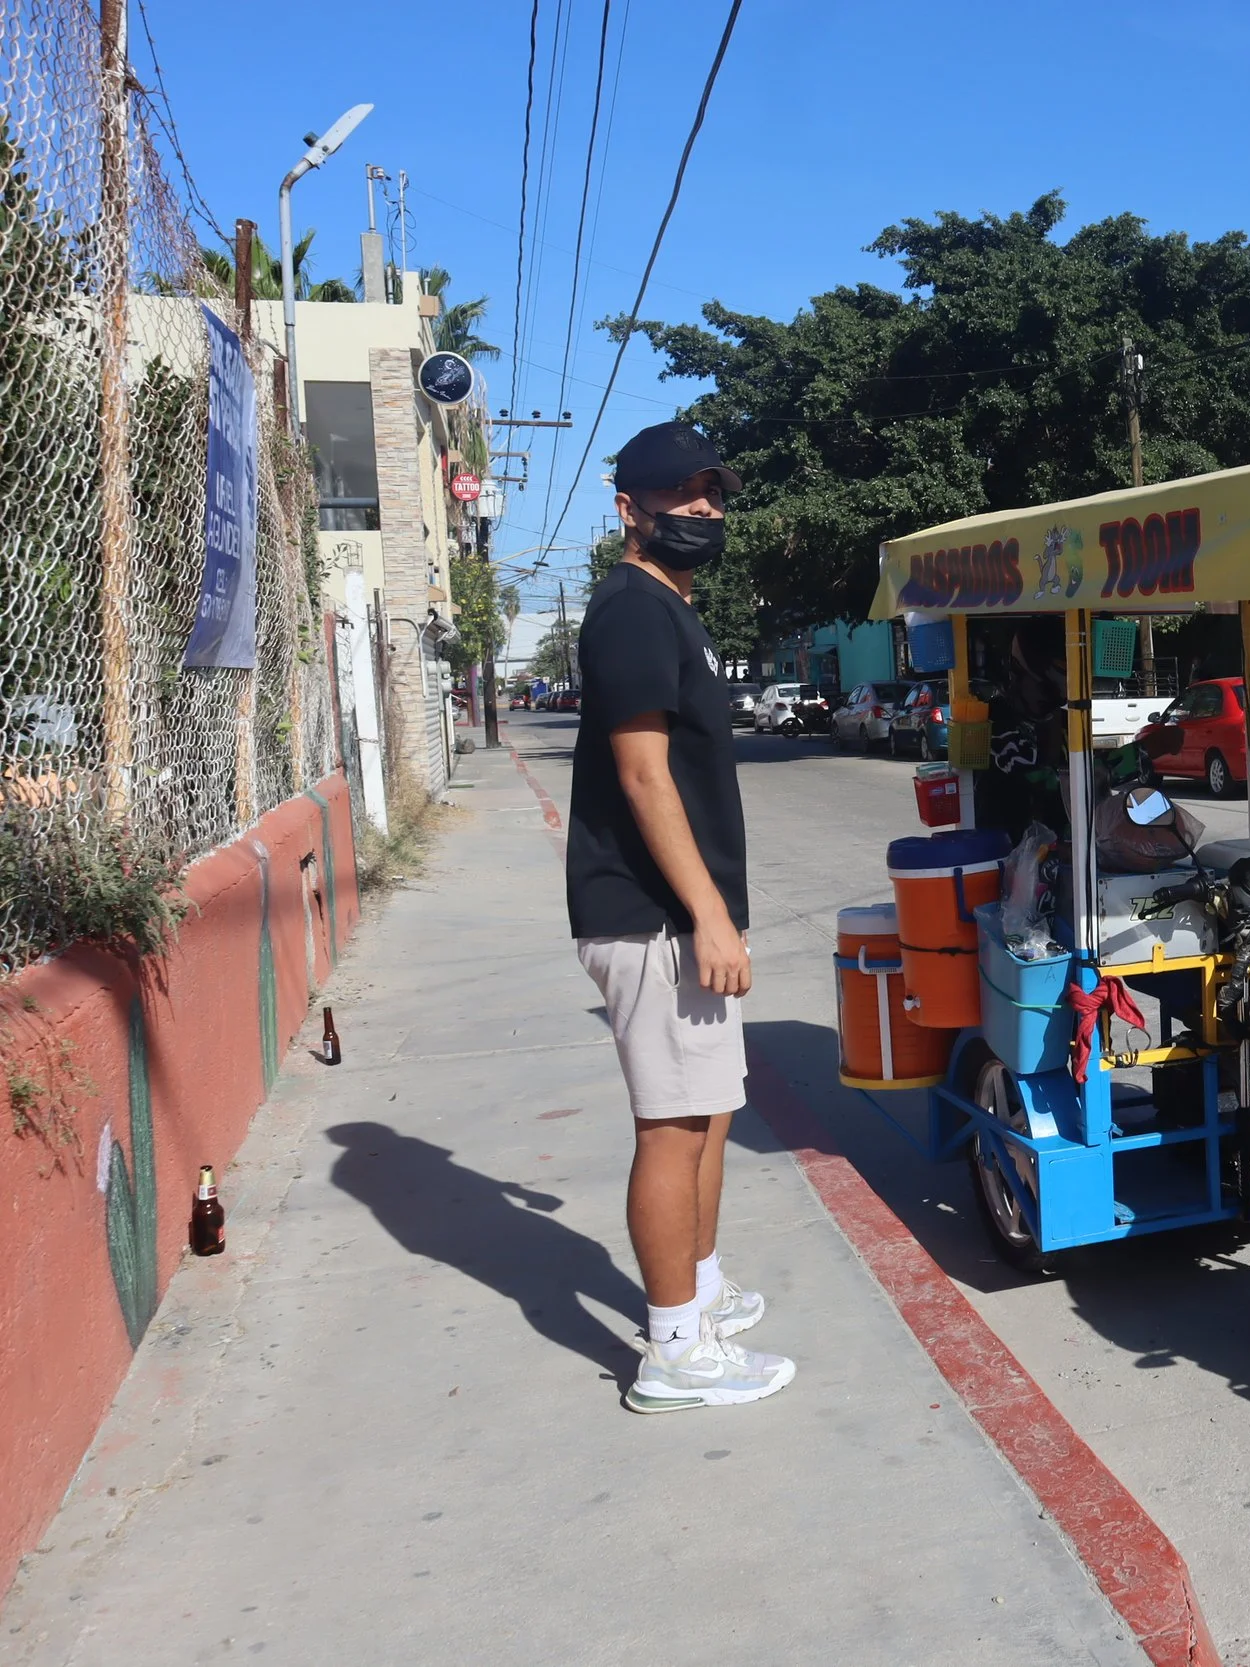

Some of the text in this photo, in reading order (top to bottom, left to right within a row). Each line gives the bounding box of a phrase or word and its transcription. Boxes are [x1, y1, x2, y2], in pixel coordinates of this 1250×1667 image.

[453, 482, 480, 492] TATTOO
[897, 507, 1201, 608] RASPADOS TOOM
